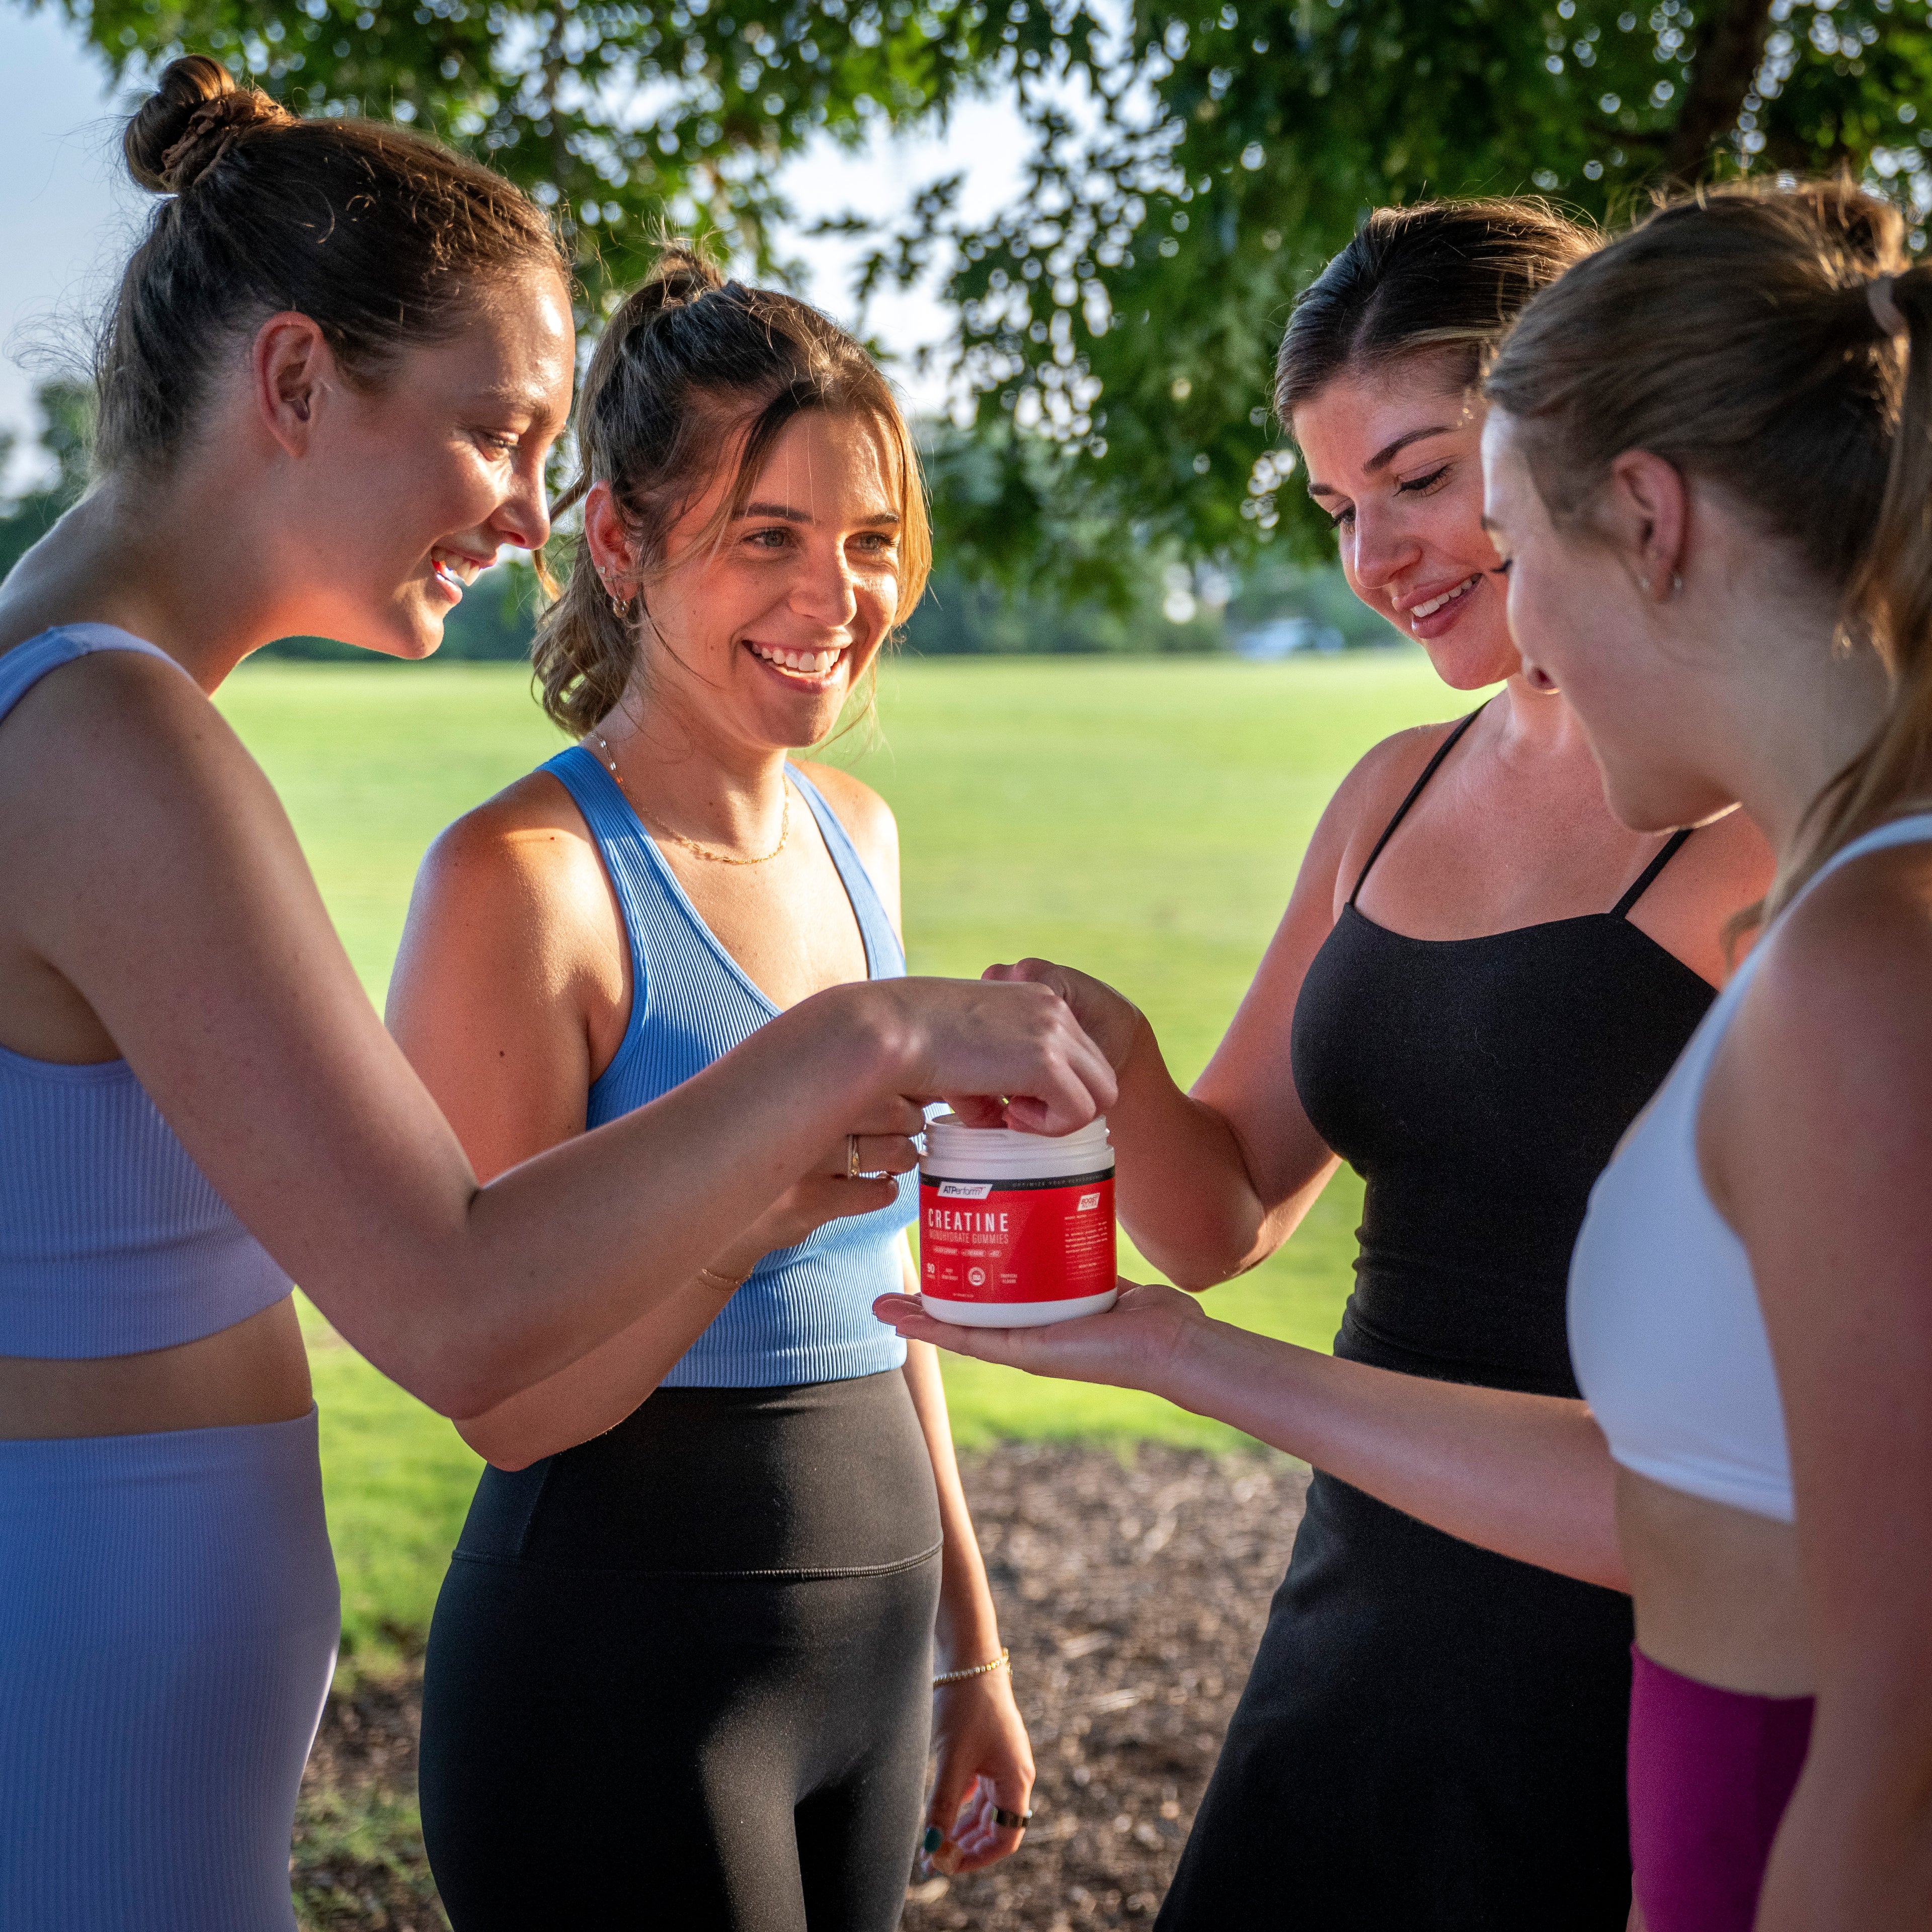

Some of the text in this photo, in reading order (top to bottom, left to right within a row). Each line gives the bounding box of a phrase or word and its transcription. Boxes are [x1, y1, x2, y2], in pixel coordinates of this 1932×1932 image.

[1081, 1195, 1099, 1204] BOOST
[928, 1208, 1008, 1232] CREATINE
[929, 1229, 1009, 1244] MONOHYDRATE GUMMIES
[927, 1263, 935, 1273] 90
